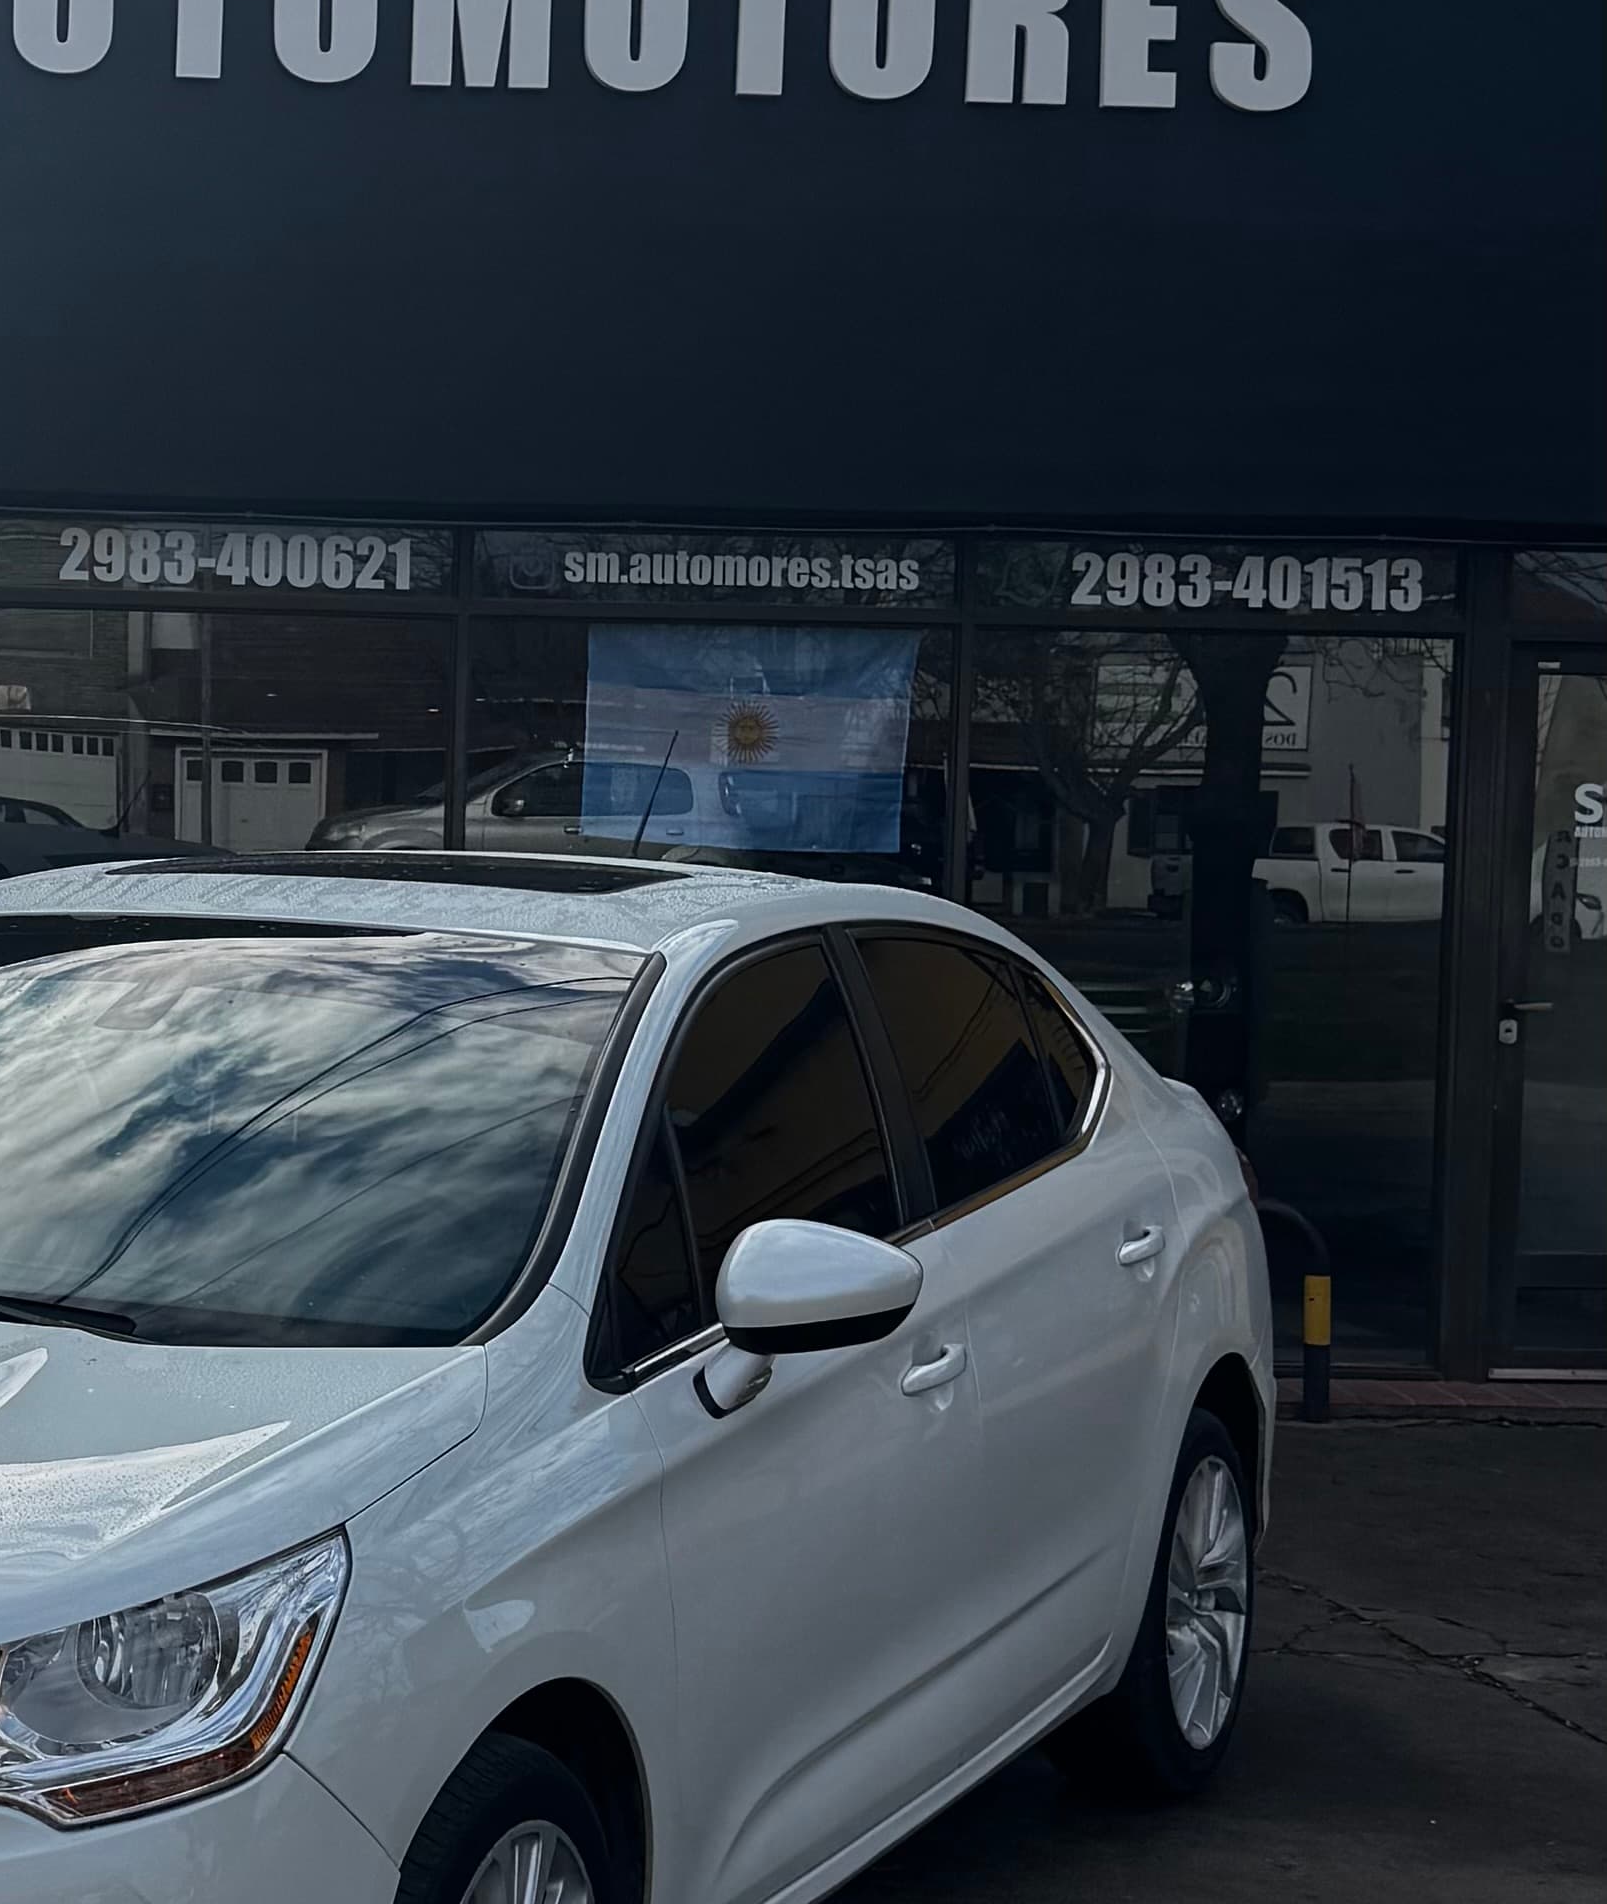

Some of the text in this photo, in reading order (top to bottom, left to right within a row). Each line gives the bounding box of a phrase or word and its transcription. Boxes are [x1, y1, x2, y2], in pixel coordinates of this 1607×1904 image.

[59, 527, 411, 590] 2983-400621
[564, 549, 920, 590] sm.automores.tsas
[1070, 551, 1423, 612] 2983-401513
